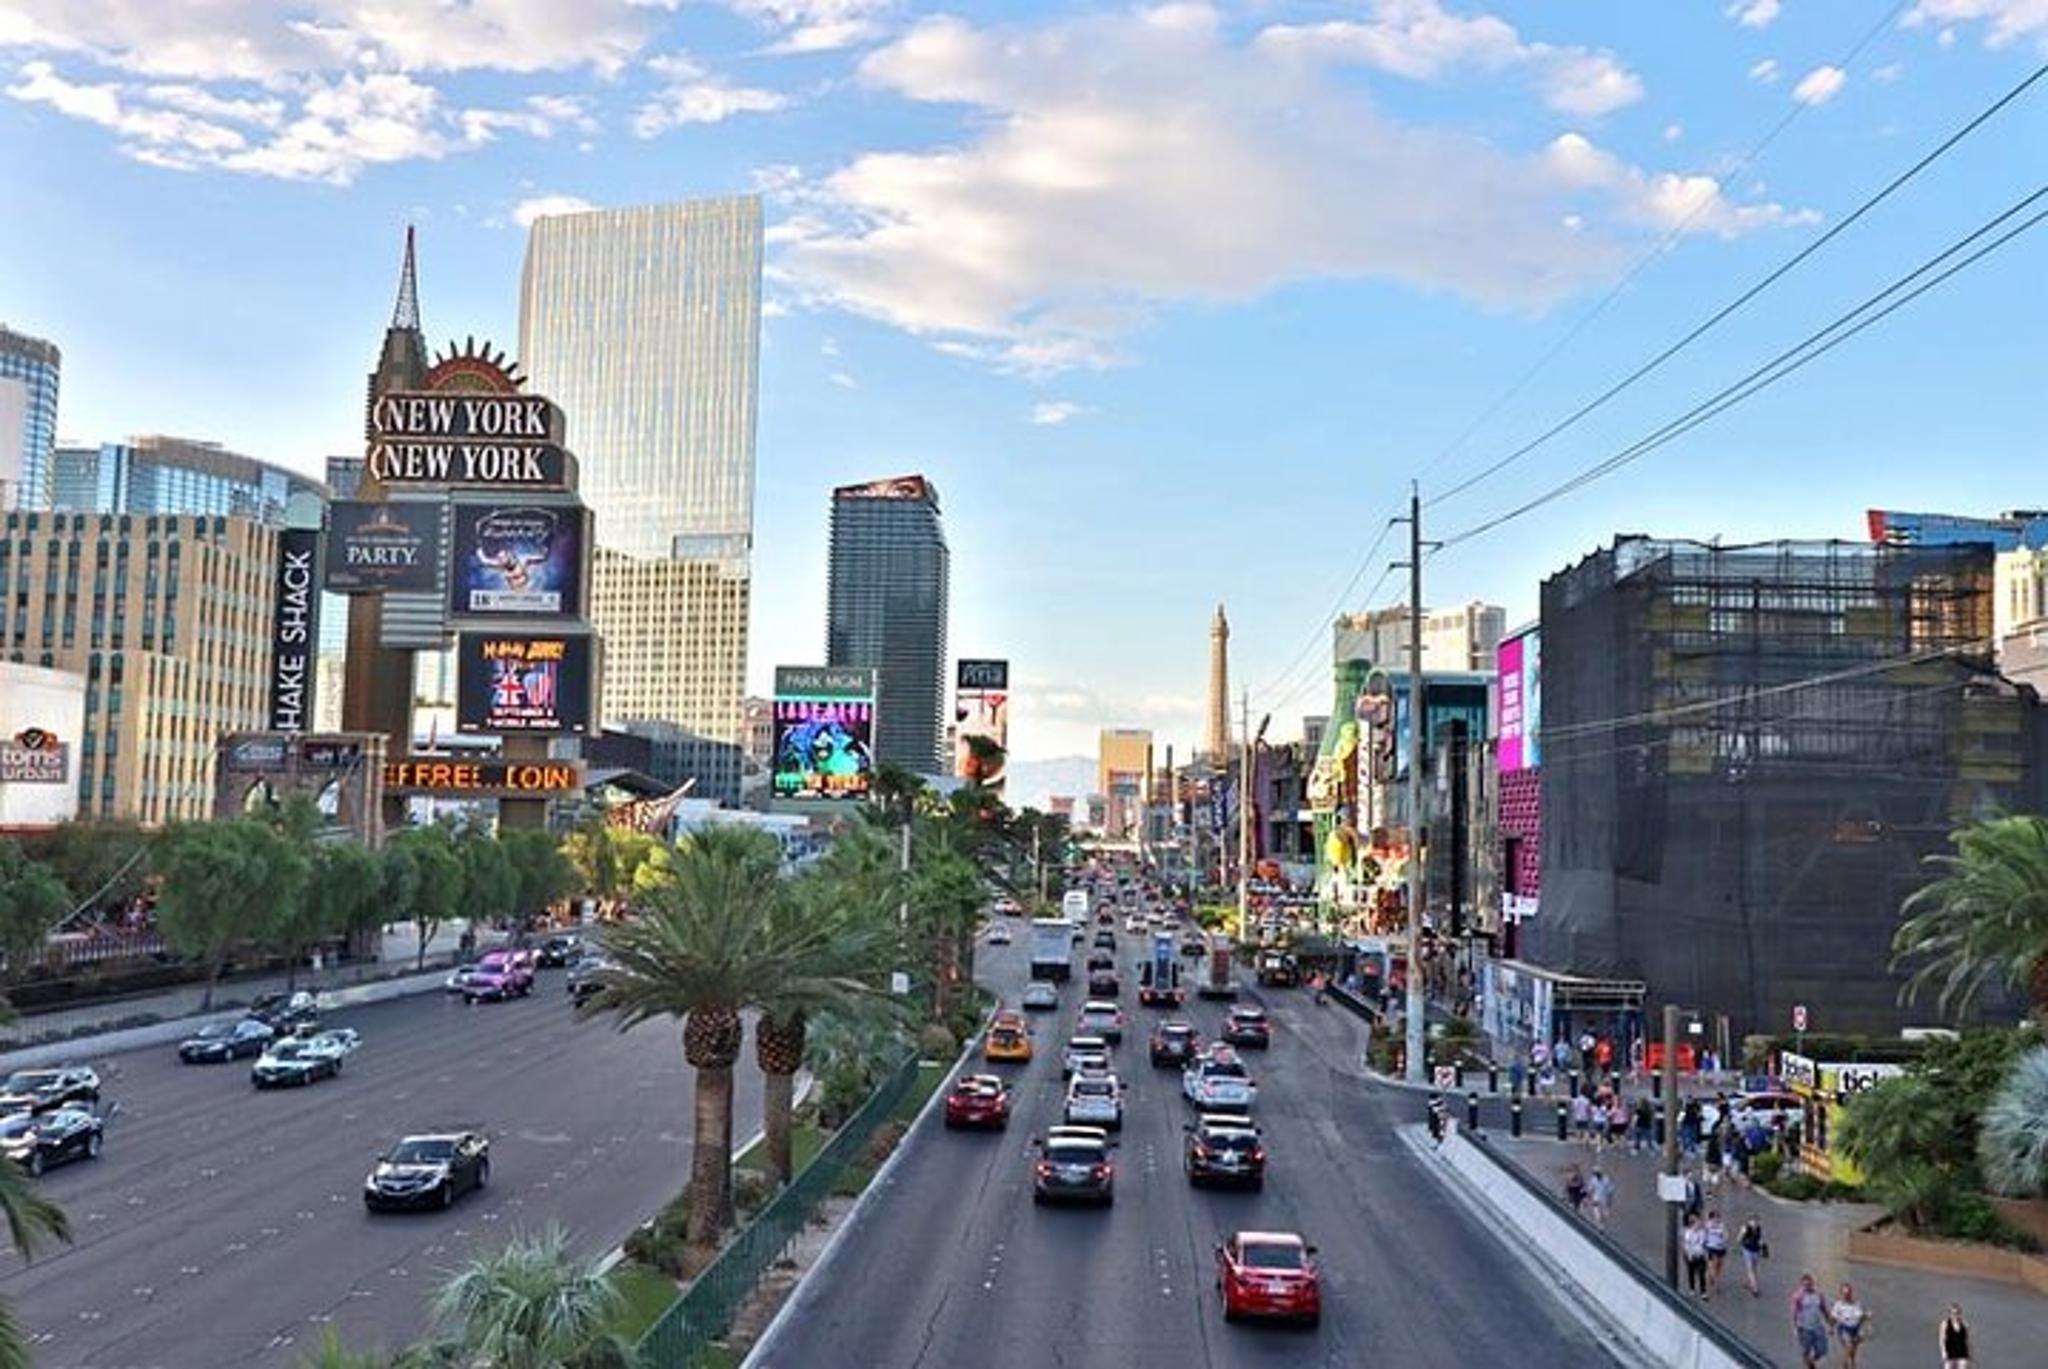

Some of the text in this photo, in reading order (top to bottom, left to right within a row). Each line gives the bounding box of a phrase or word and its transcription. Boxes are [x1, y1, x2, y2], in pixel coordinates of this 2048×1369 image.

[386, 398, 546, 435] NEW YORK
[384, 444, 544, 481] NEW YORK
[276, 550, 312, 732] HAKE SHACK
[2, 766, 61, 779] urban
